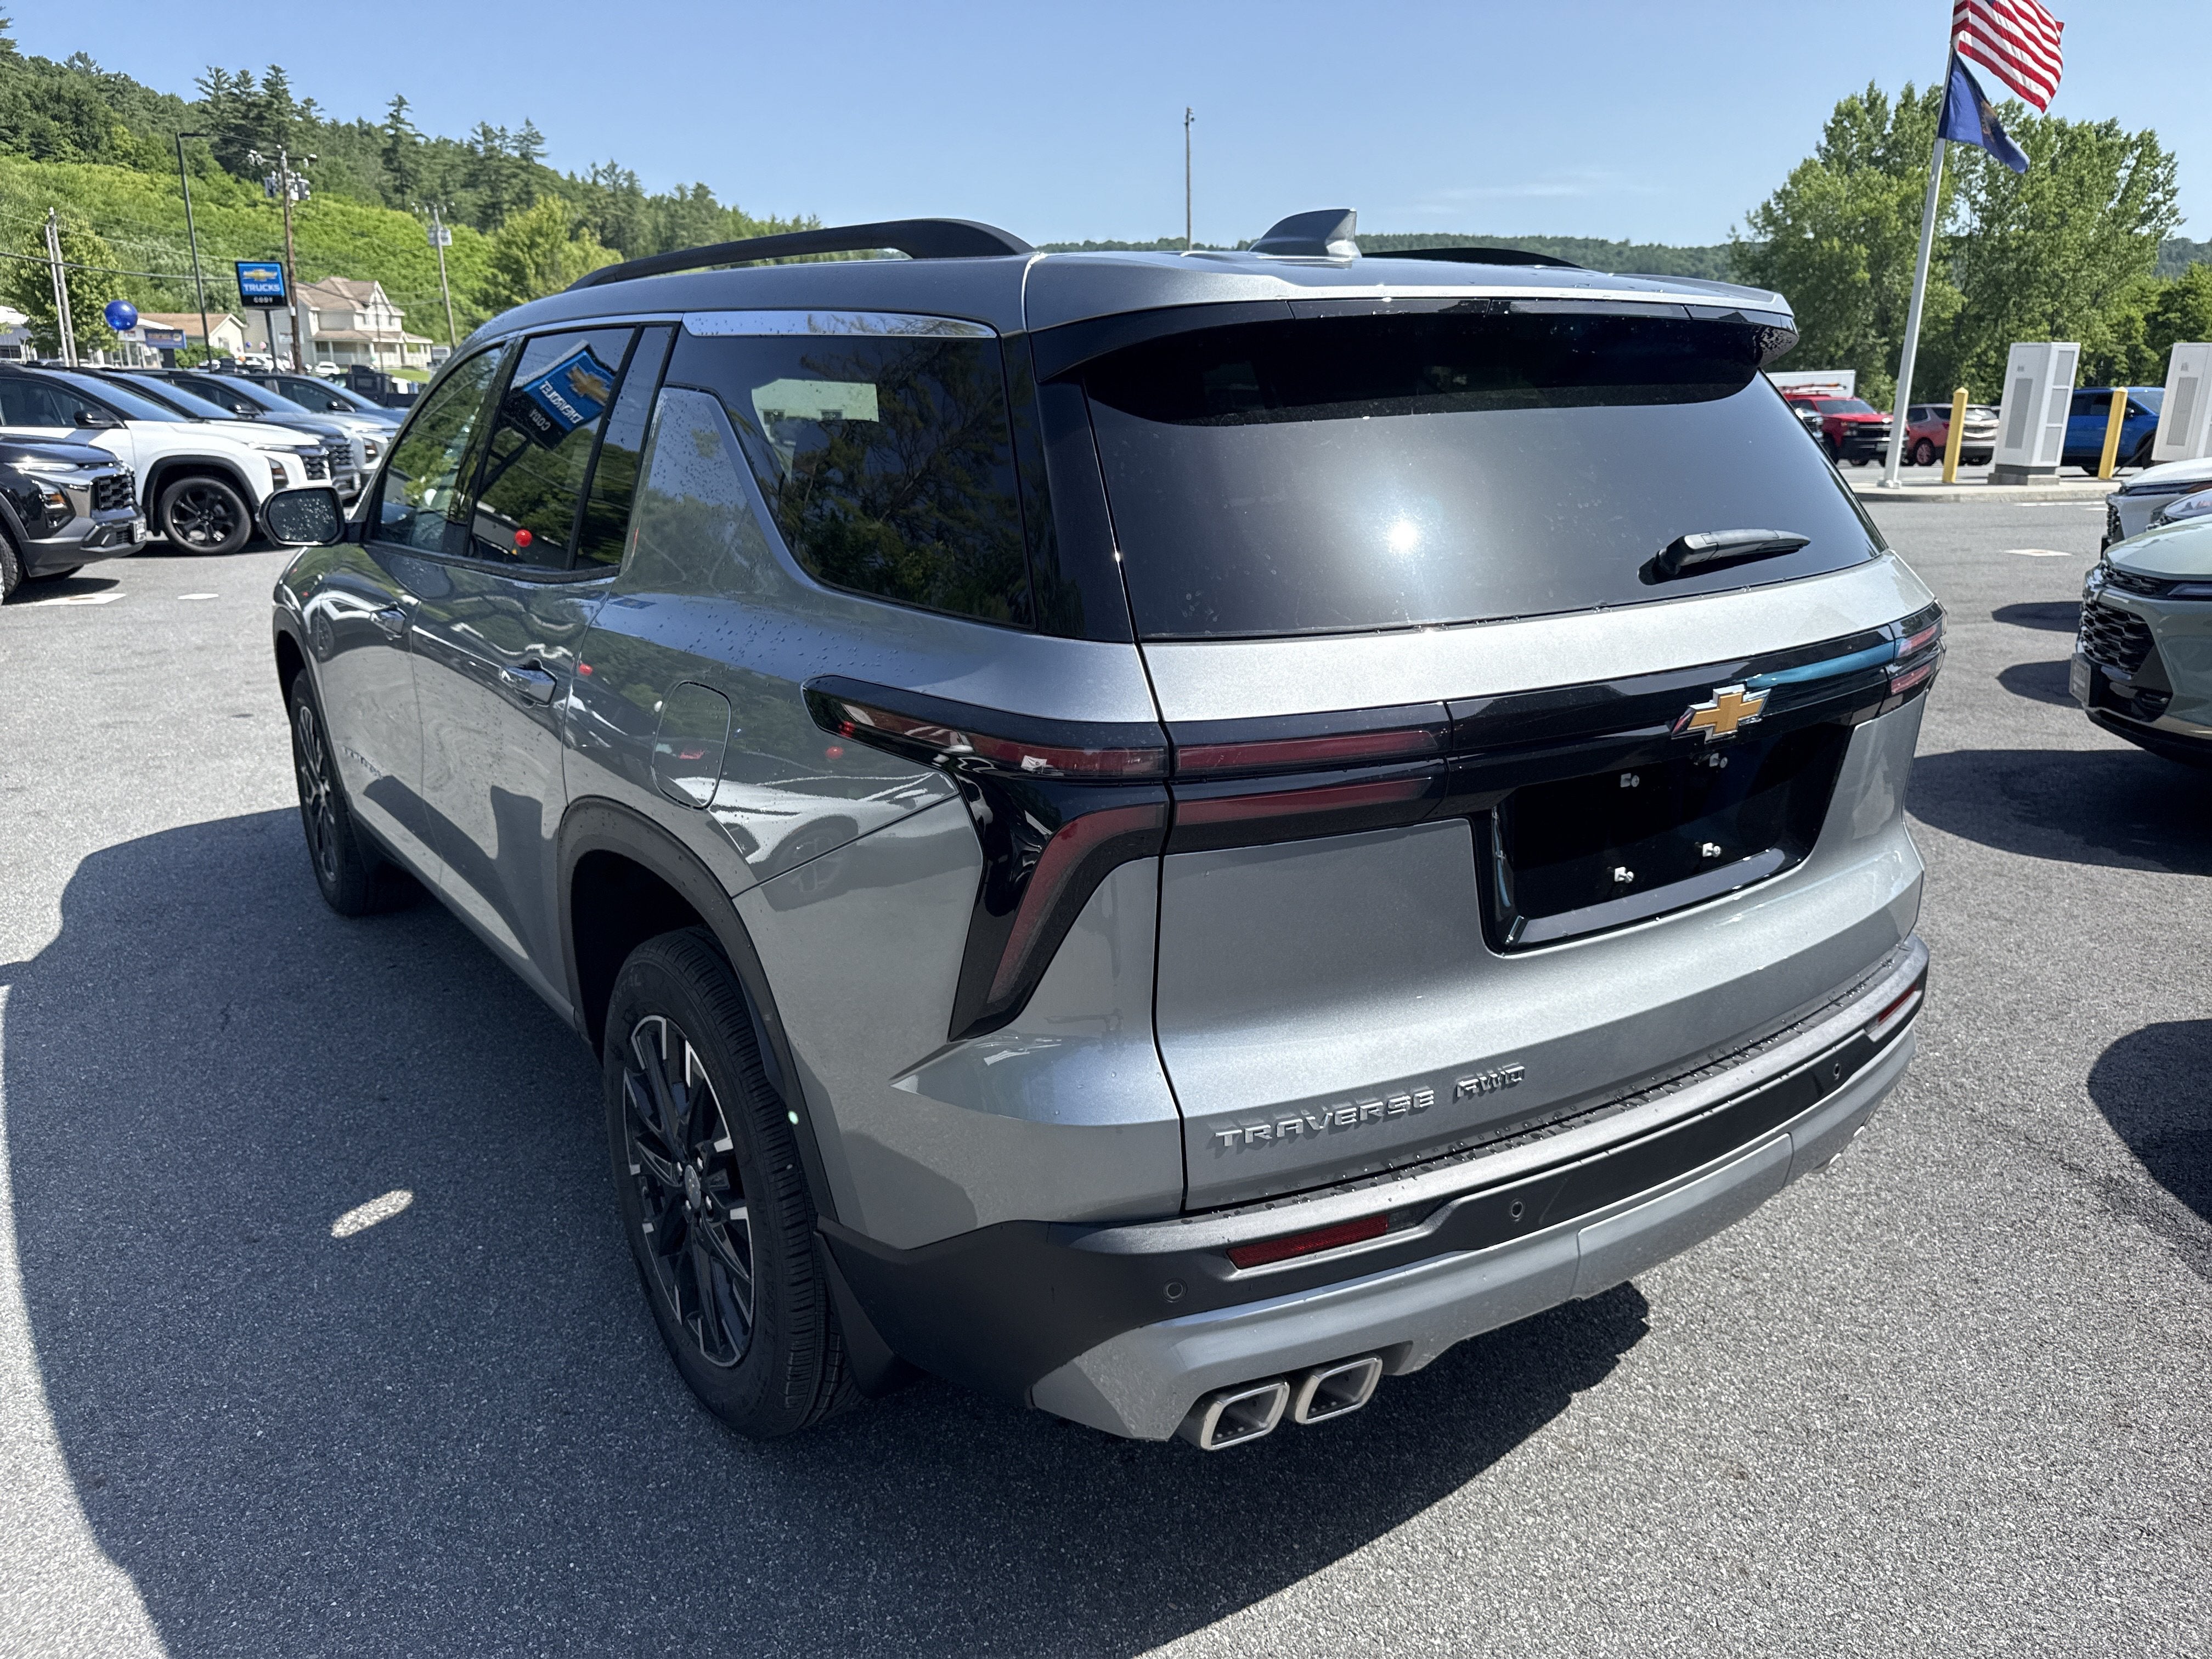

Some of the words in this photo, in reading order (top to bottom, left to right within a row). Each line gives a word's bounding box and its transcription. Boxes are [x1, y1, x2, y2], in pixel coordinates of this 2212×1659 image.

[243, 283, 280, 292] TRUCKS
[1215, 1090, 1434, 1147] TRAVERSE
[1457, 1066, 1525, 1097] AWD
